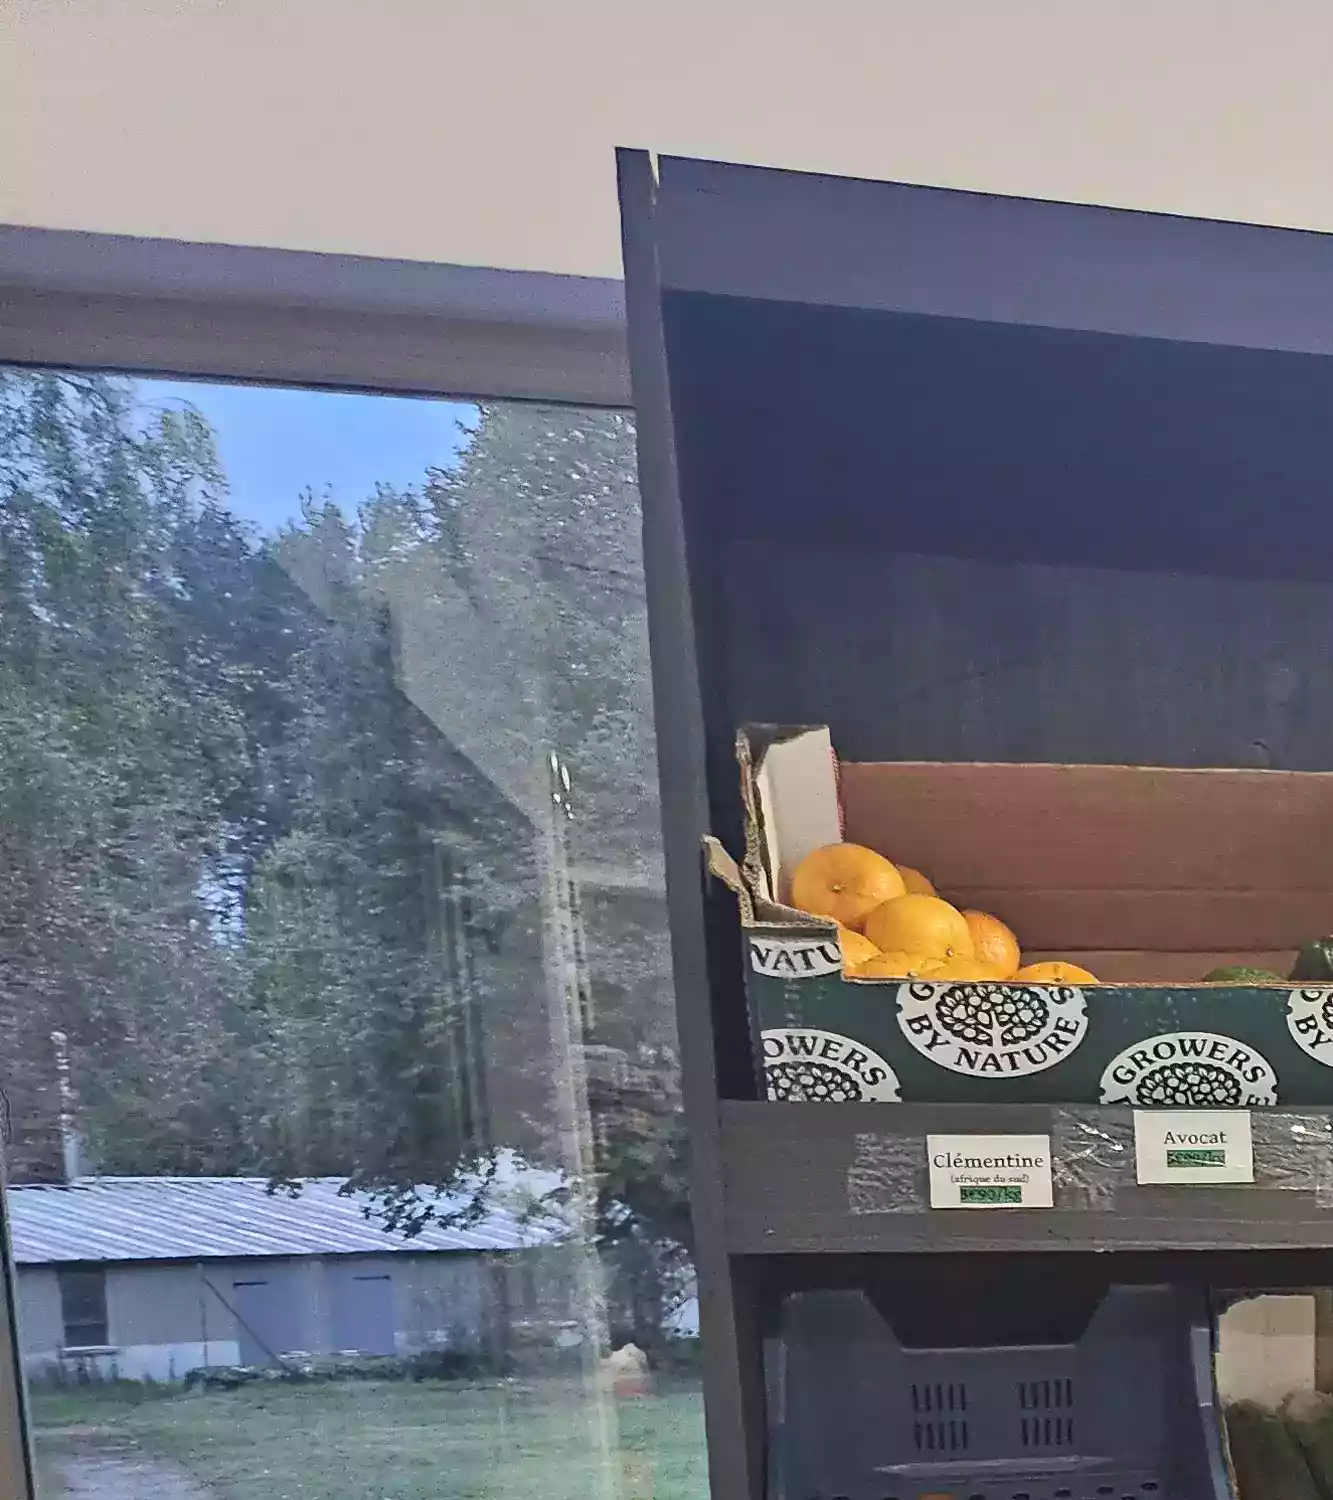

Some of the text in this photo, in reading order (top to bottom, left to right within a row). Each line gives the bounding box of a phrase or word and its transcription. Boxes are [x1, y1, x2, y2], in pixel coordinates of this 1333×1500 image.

[906, 1014, 1081, 1073] BY NATURE
[1295, 1014, 1333, 1050] BY
[1112, 1038, 1267, 1085] GROWERS
[1163, 1131, 1228, 1145] Avocat
[933, 1152, 1045, 1169] Clémentine
